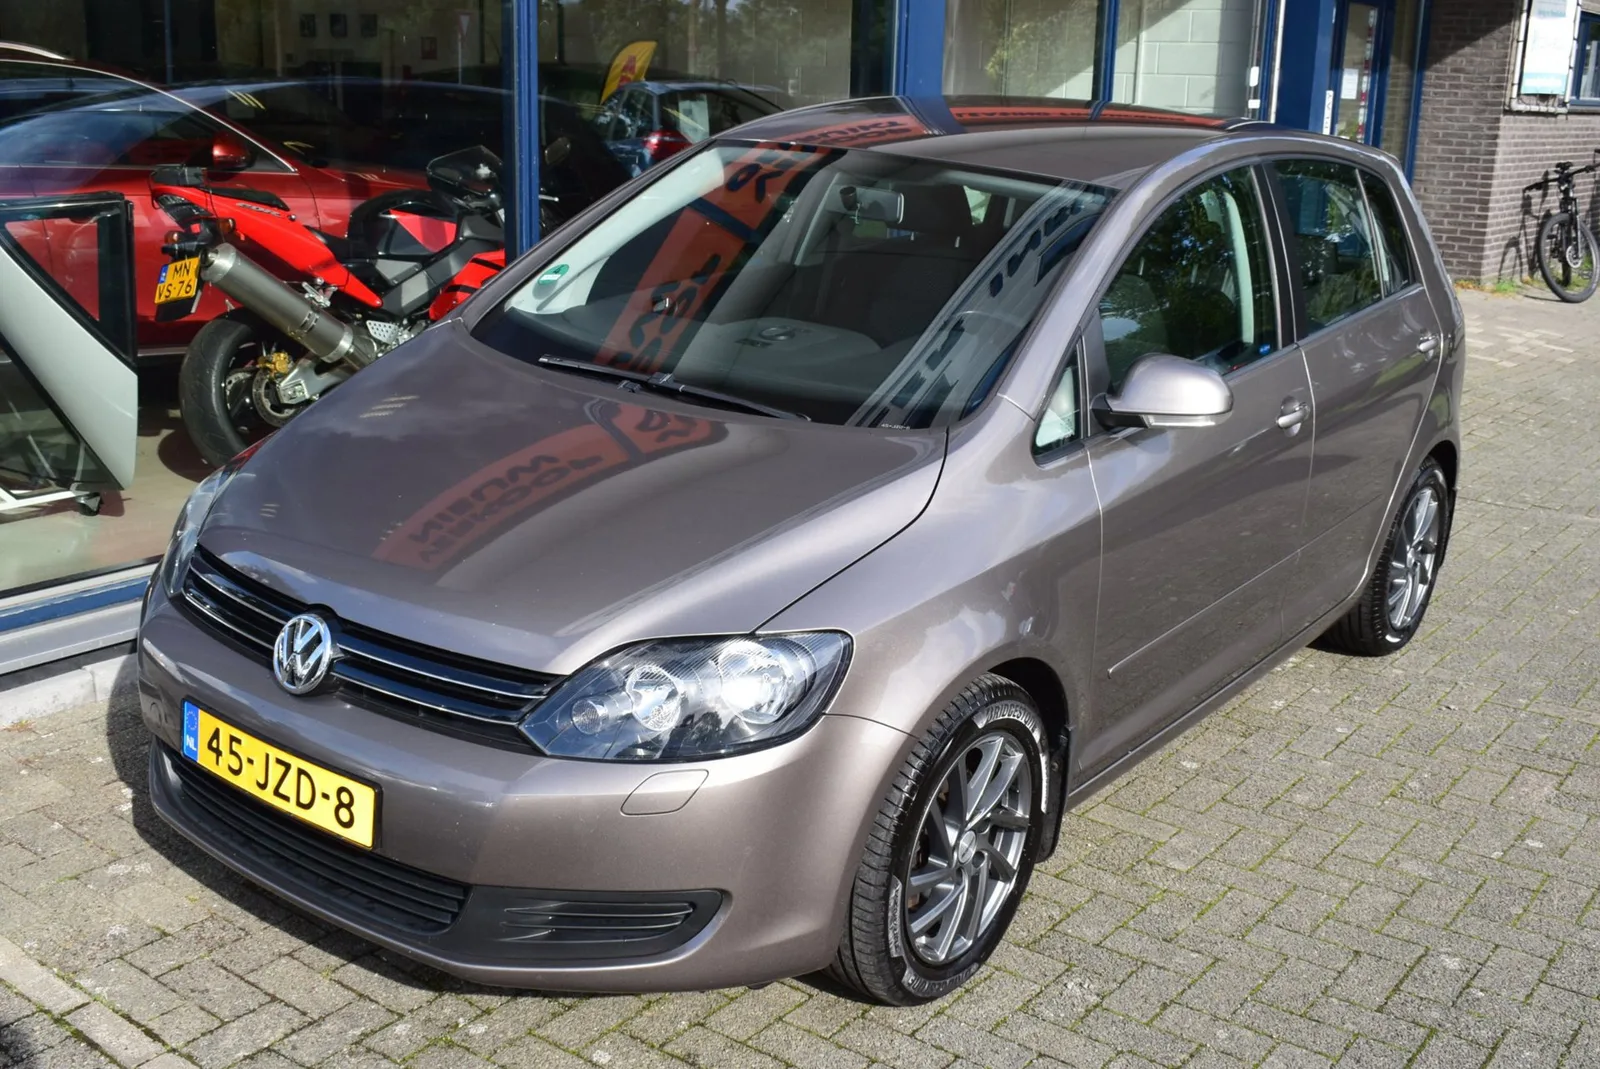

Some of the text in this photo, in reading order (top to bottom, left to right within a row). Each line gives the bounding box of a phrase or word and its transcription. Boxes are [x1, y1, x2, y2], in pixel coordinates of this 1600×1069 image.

[172, 261, 192, 280] MN
[185, 733, 197, 752] NL
[206, 726, 356, 829] 45-JZD-8
